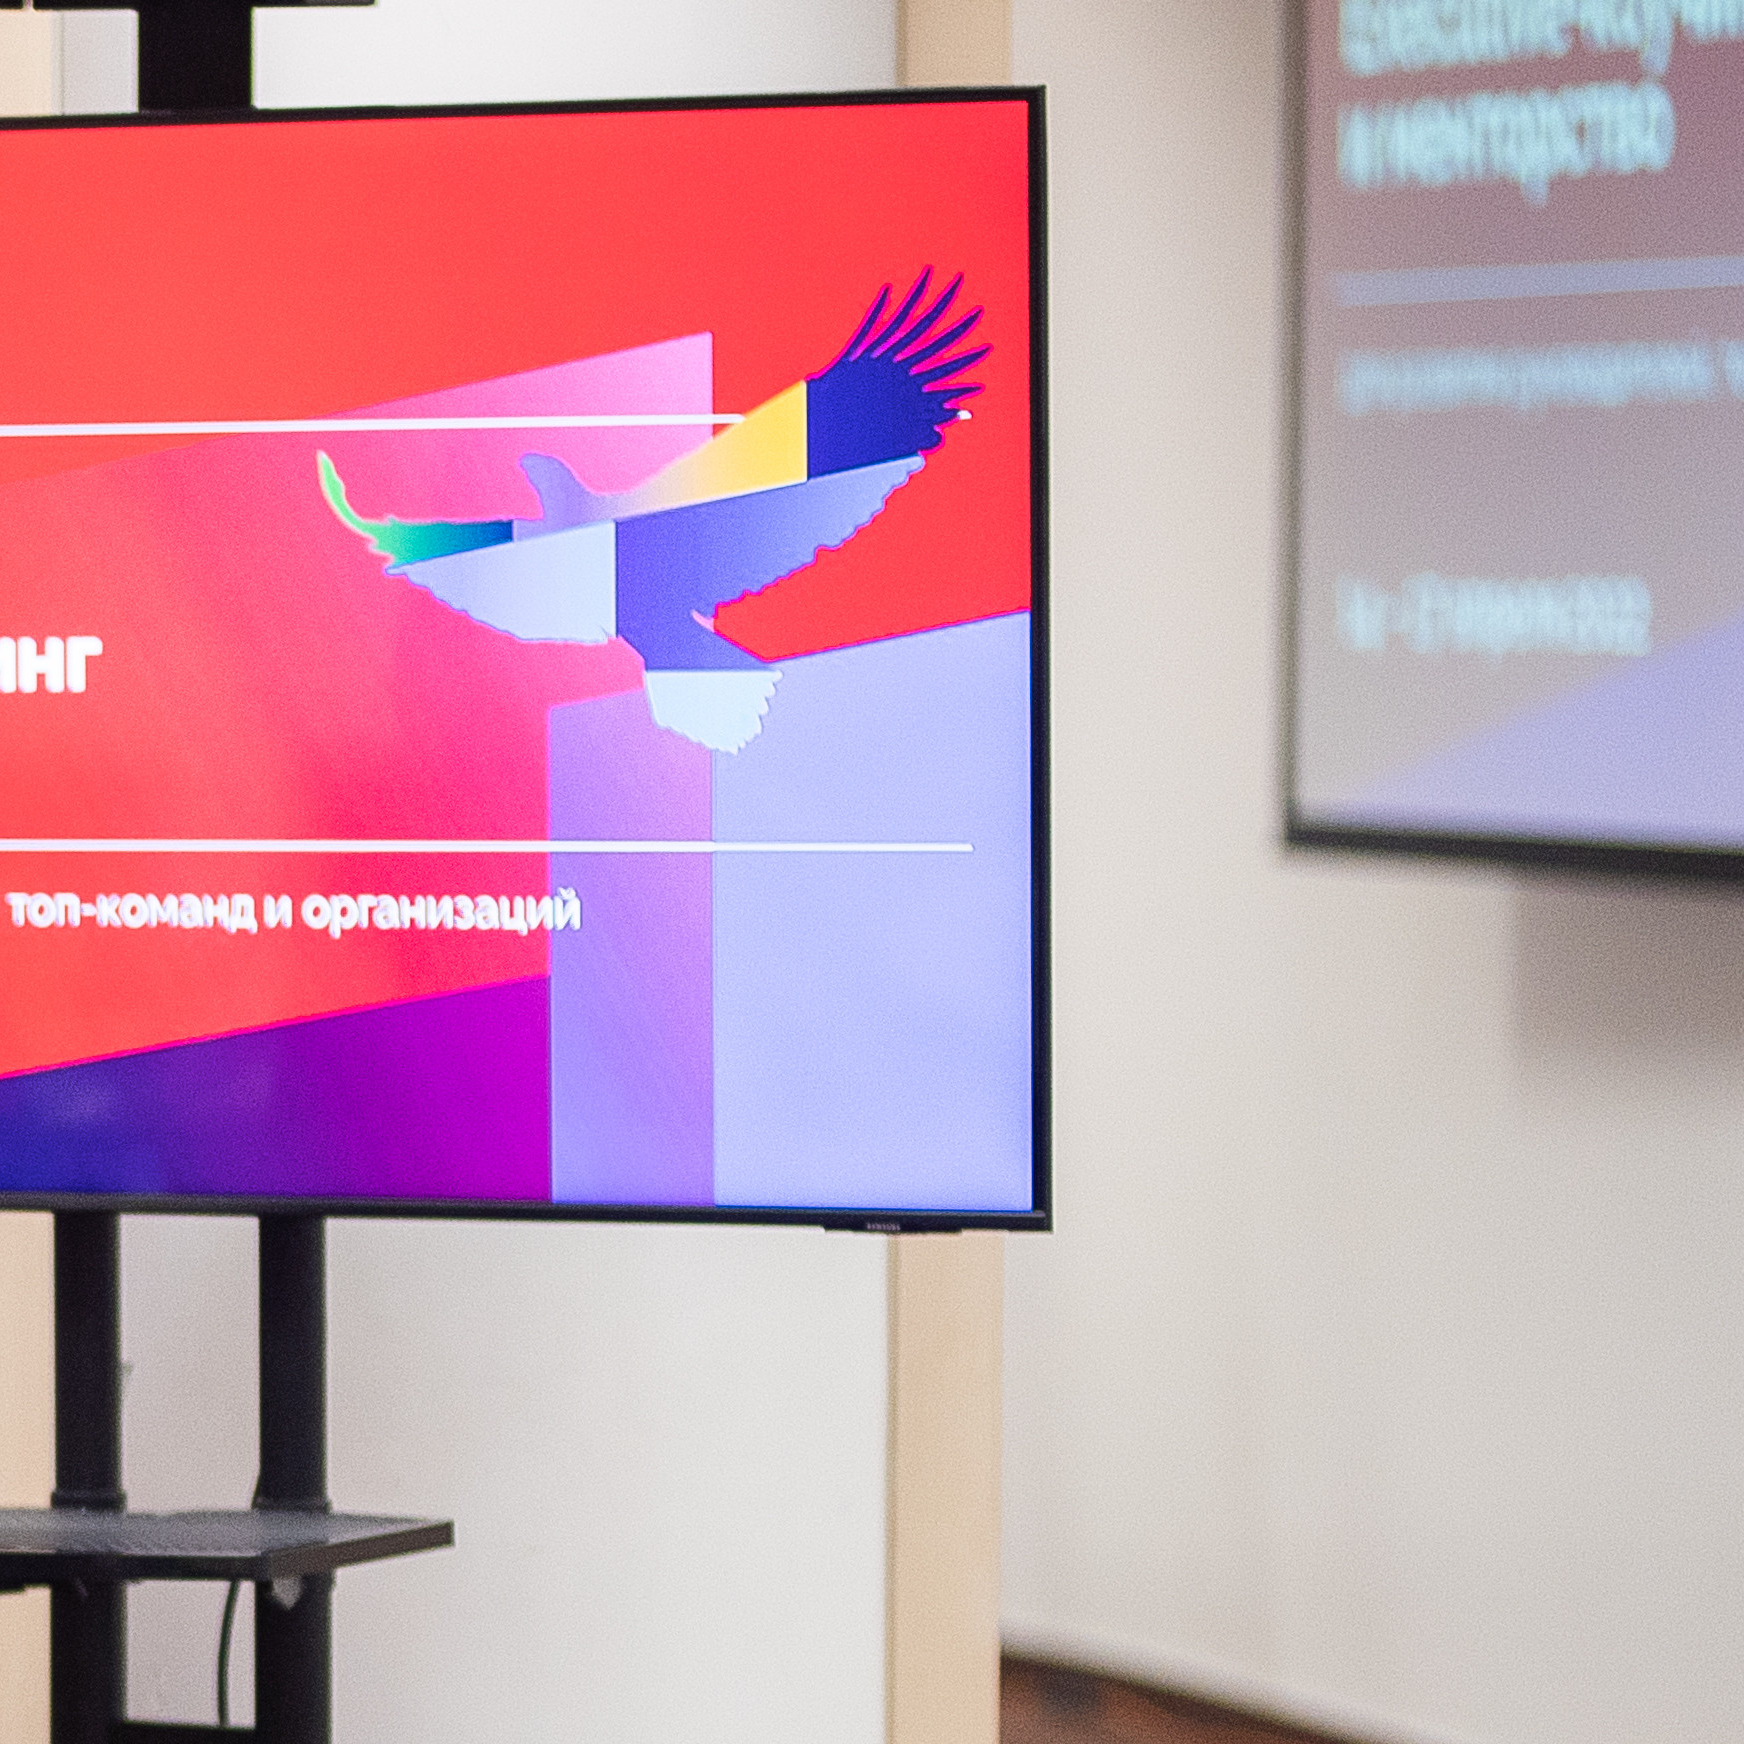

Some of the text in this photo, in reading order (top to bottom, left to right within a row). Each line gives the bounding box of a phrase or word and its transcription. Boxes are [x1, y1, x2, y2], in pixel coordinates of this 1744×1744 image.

[5, 891, 259, 935] топ-команд
[263, 895, 293, 928] и
[301, 886, 582, 941] организаций
